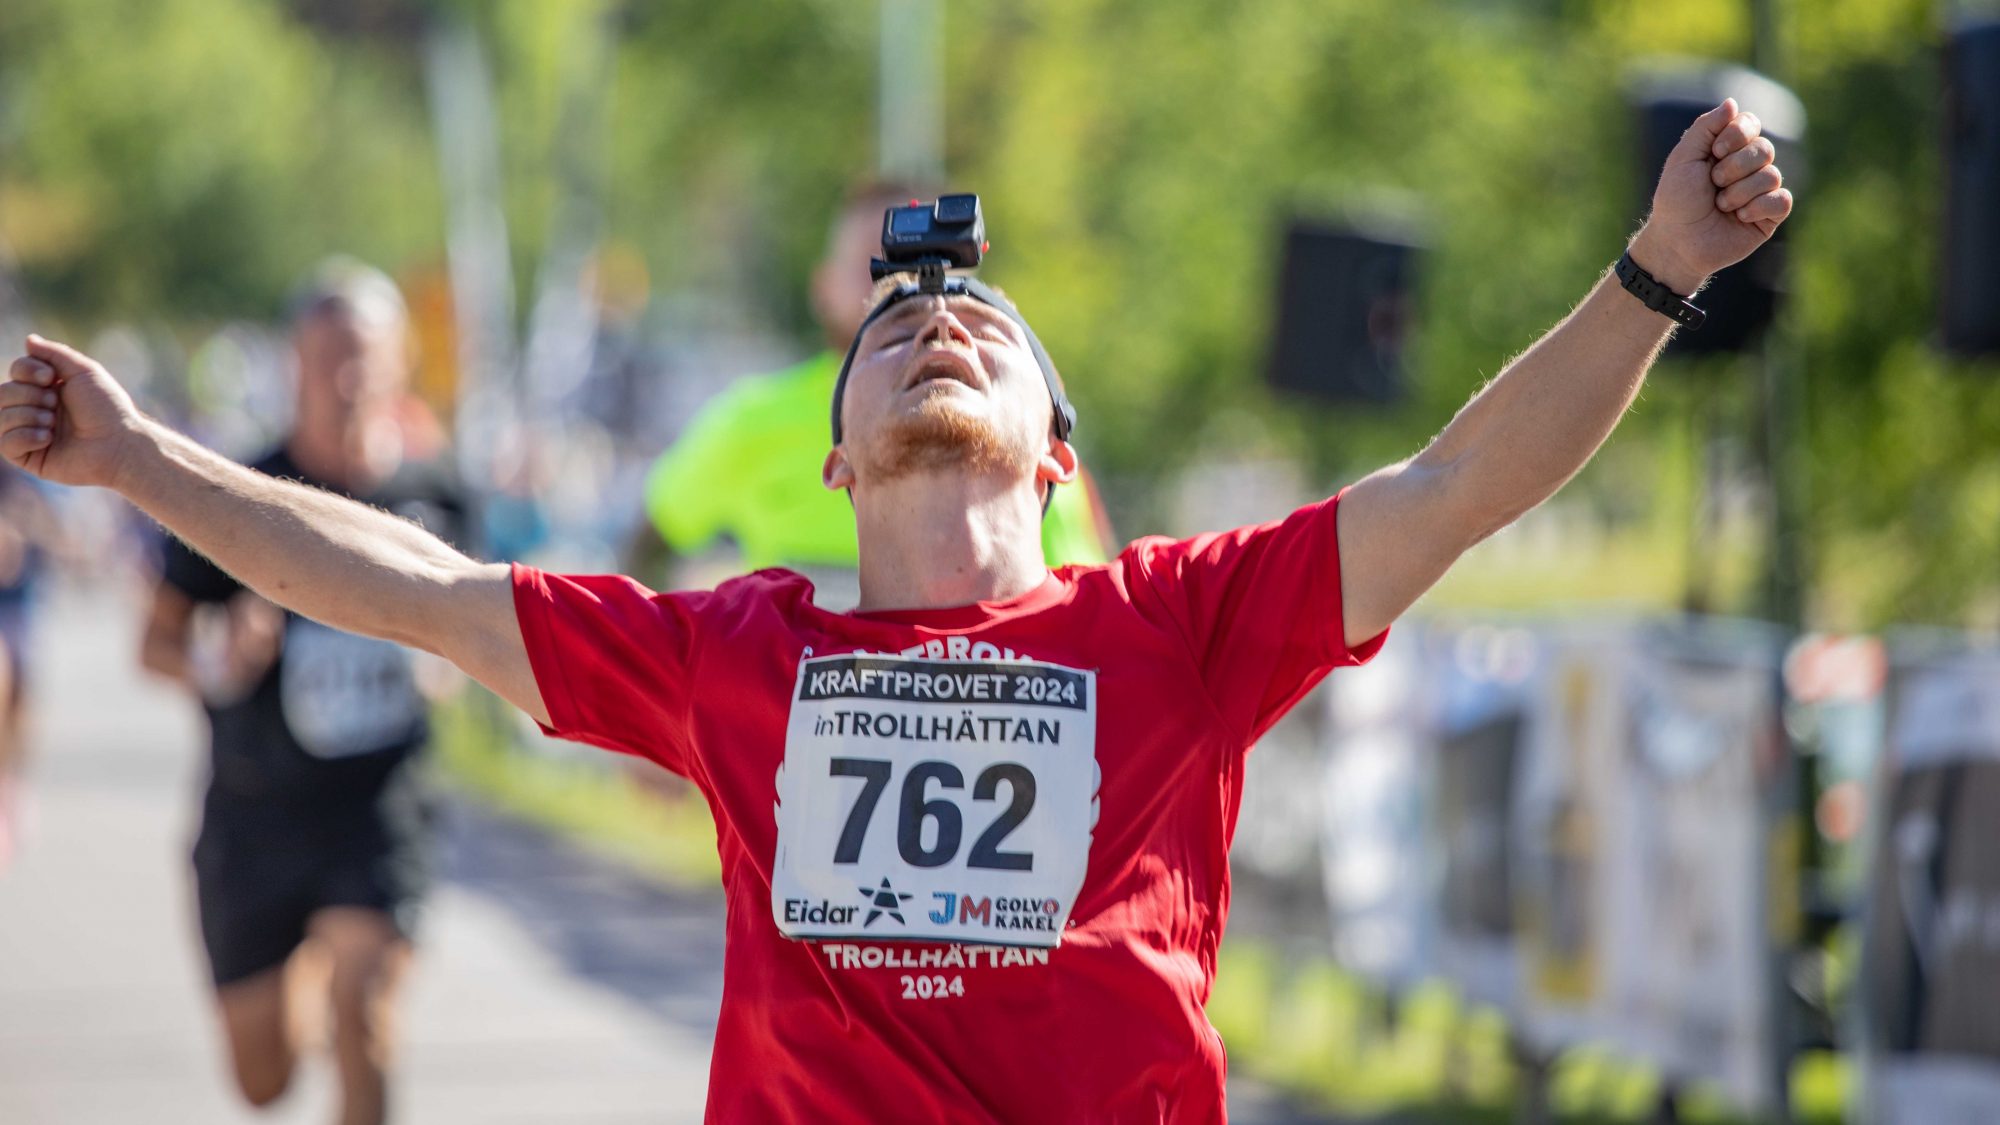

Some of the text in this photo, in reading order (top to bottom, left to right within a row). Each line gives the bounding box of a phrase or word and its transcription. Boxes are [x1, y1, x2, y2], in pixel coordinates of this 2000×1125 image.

[809, 669, 1077, 704] KRAFTPROVET 2024
[829, 757, 1036, 871] 762
[784, 899, 859, 924] Eidar
[928, 891, 992, 926] JM
[995, 914, 1057, 932] KAKEL
[822, 943, 1049, 969] TROLLHÄTTAN
[901, 975, 965, 999] 2024
